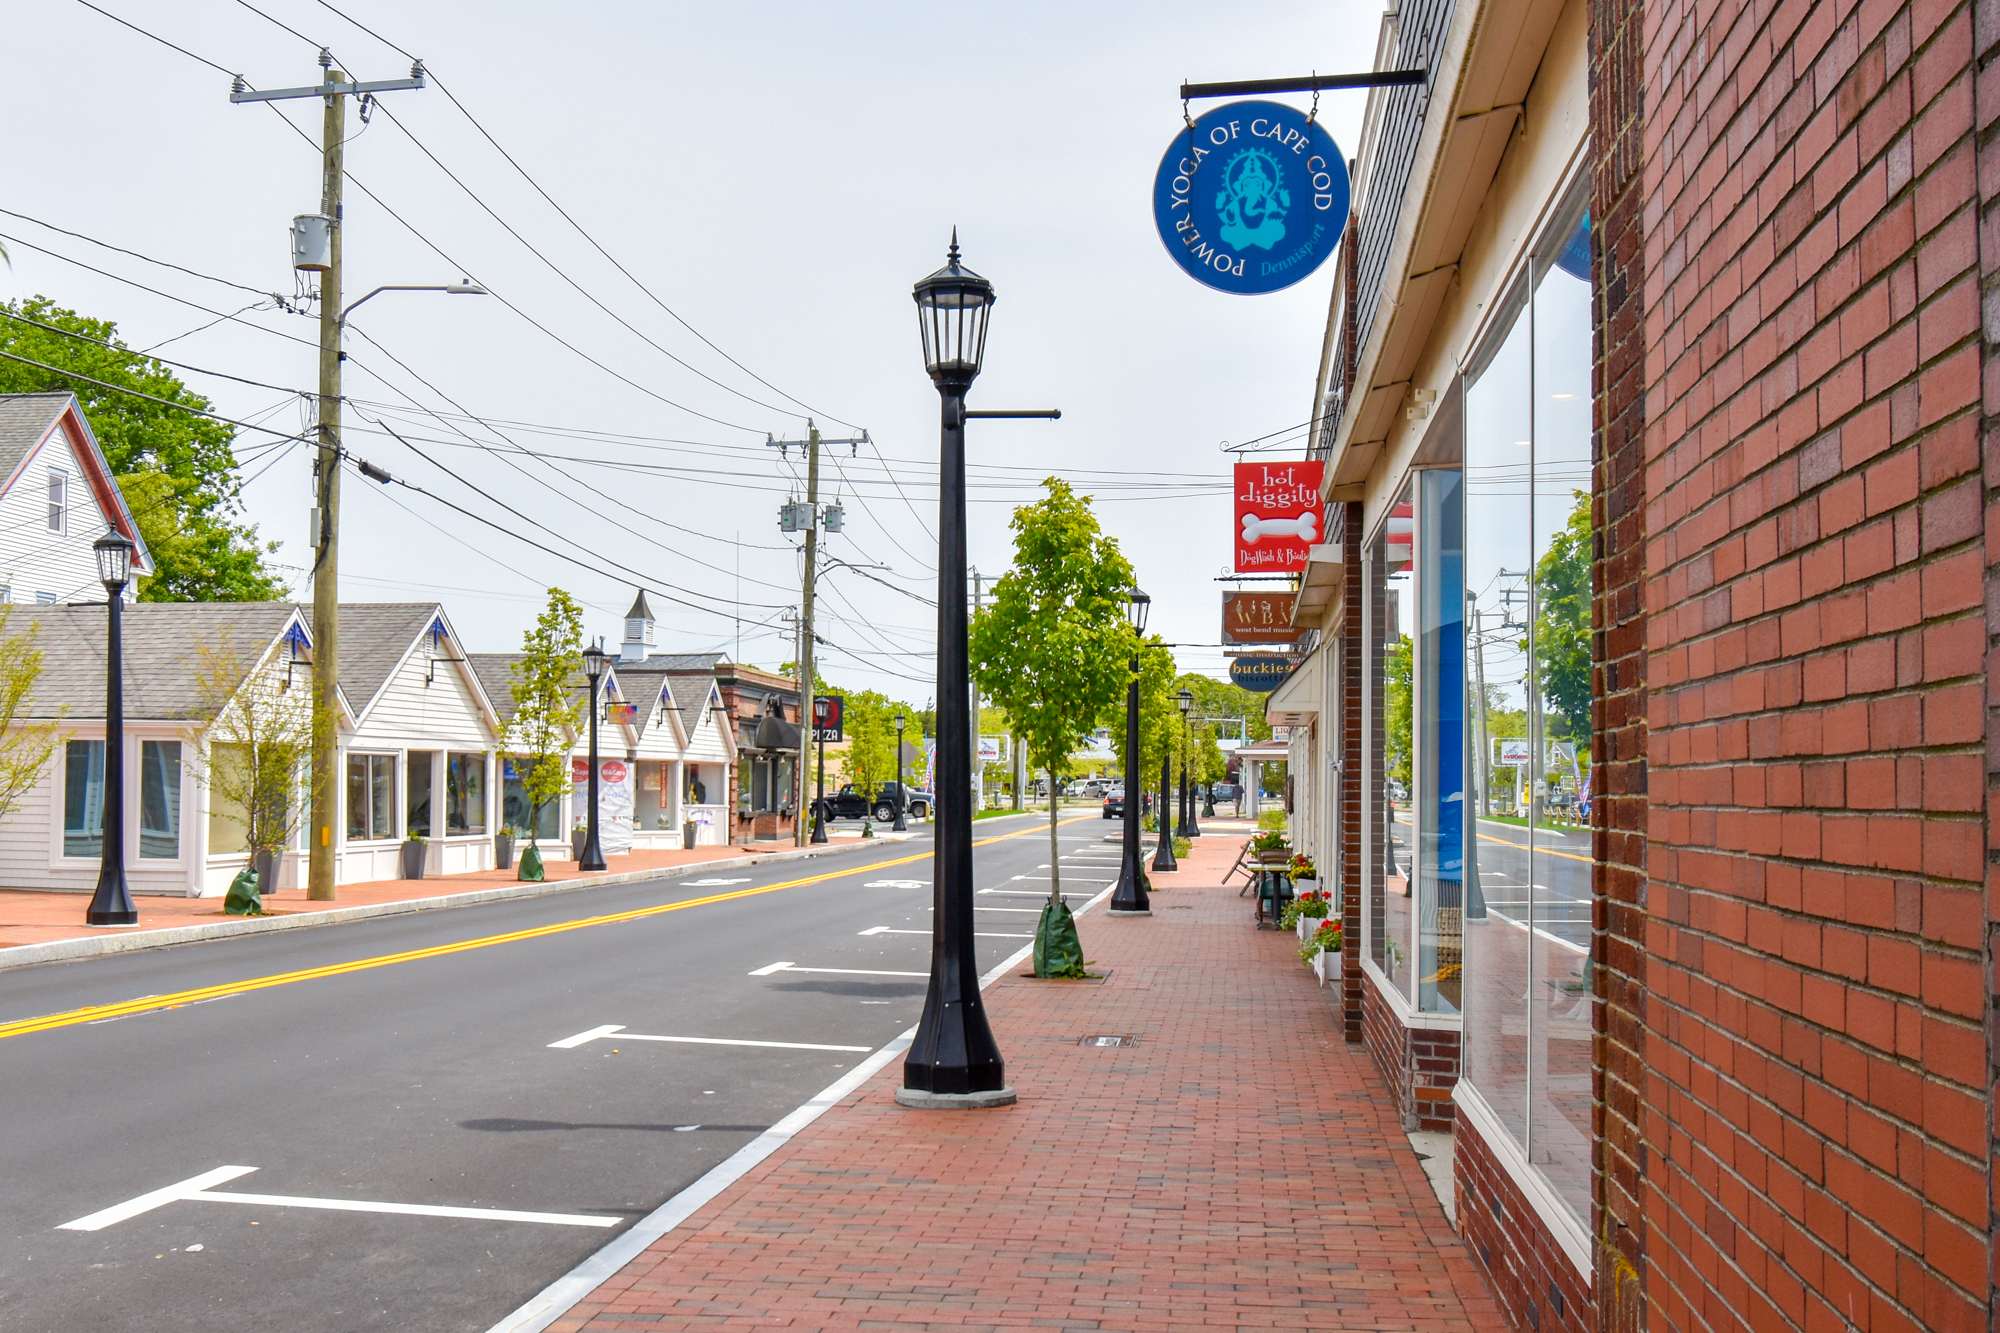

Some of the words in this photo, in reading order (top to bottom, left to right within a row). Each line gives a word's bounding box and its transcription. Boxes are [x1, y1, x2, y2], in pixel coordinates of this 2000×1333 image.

[1210, 120, 1240, 145] OF
[1251, 118, 1310, 155] CAPE
[1171, 146, 1210, 210] YOGA
[1306, 155, 1332, 211] COD
[1175, 213, 1247, 276] POWER
[1261, 223, 1325, 276] Dennisport
[1261, 466, 1296, 487] hot
[1239, 481, 1317, 508] diggity
[1277, 547, 1284, 563] &
[1233, 662, 1292, 674] buckies
